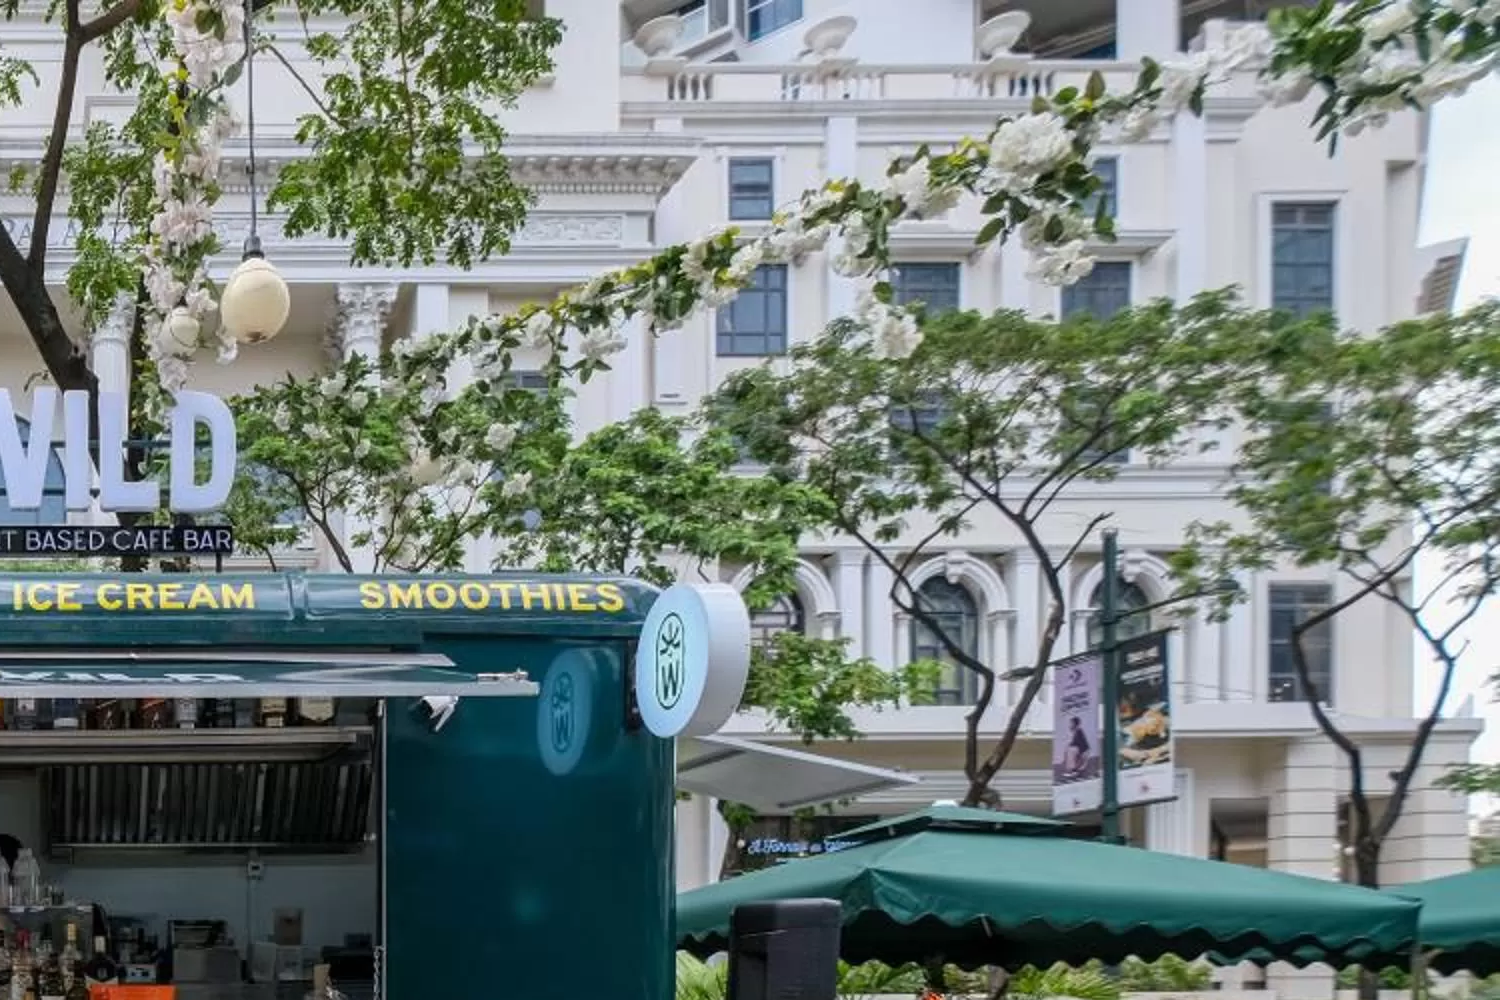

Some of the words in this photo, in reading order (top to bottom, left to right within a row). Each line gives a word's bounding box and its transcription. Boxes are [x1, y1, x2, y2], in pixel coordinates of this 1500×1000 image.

[26, 530, 105, 550] BASED
[113, 530, 173, 550] CAFE
[183, 530, 232, 549] BAR
[13, 582, 85, 611] ICE
[97, 582, 256, 611] CREAM
[360, 582, 625, 612] SMOOTHIES
[661, 661, 680, 701] W
